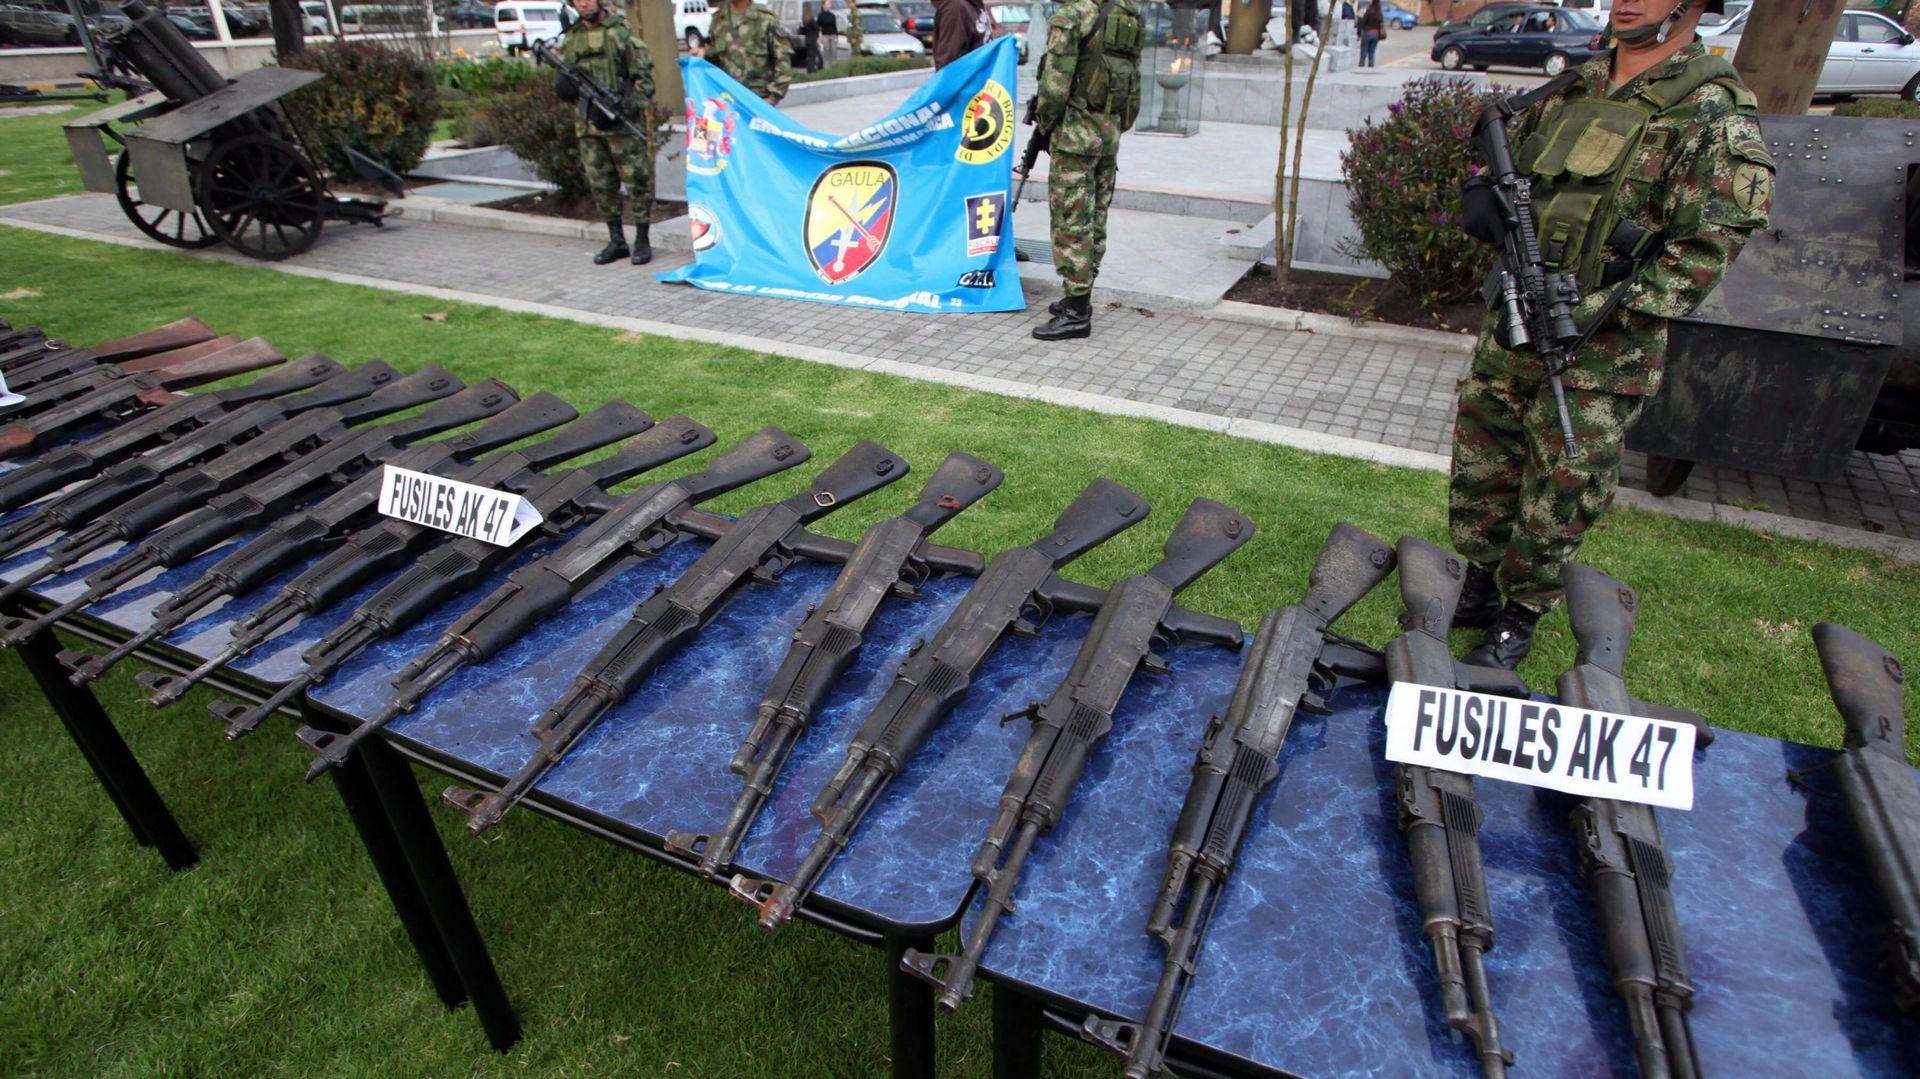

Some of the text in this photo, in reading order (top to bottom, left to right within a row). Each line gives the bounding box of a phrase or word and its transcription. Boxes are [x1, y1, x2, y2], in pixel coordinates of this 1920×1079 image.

[831, 171, 884, 187] GAULA
[390, 474, 509, 542] FUSILES AK 47
[1413, 689, 1677, 790] FUSILES AK 47
